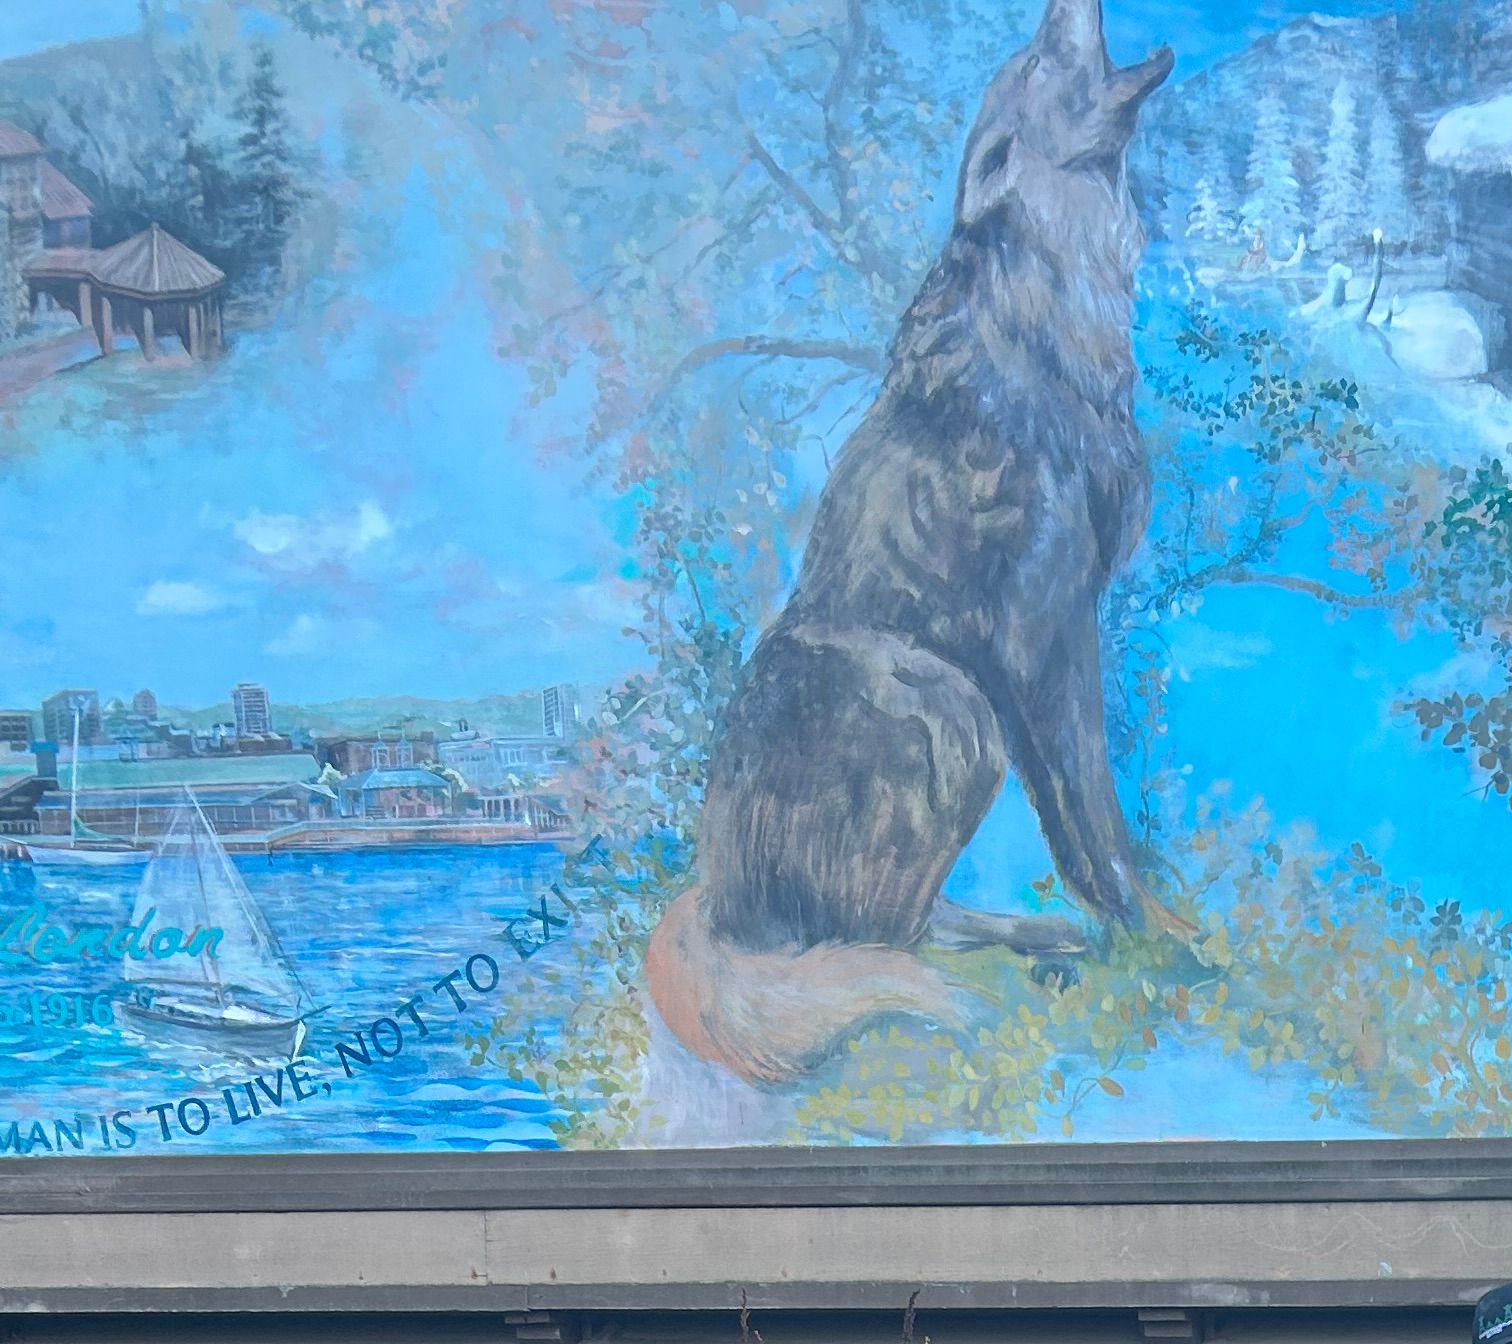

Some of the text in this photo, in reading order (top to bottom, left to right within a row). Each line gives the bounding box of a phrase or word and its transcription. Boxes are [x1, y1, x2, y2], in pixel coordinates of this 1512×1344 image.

[0, 1118, 84, 1154] MAN
[97, 1110, 136, 1151] IS
[146, 1097, 210, 1142] TO
[223, 1060, 332, 1126] LIVE,
[334, 995, 430, 1078] NOT
[433, 953, 500, 1013] TO
[30, 991, 114, 1028] 1916
